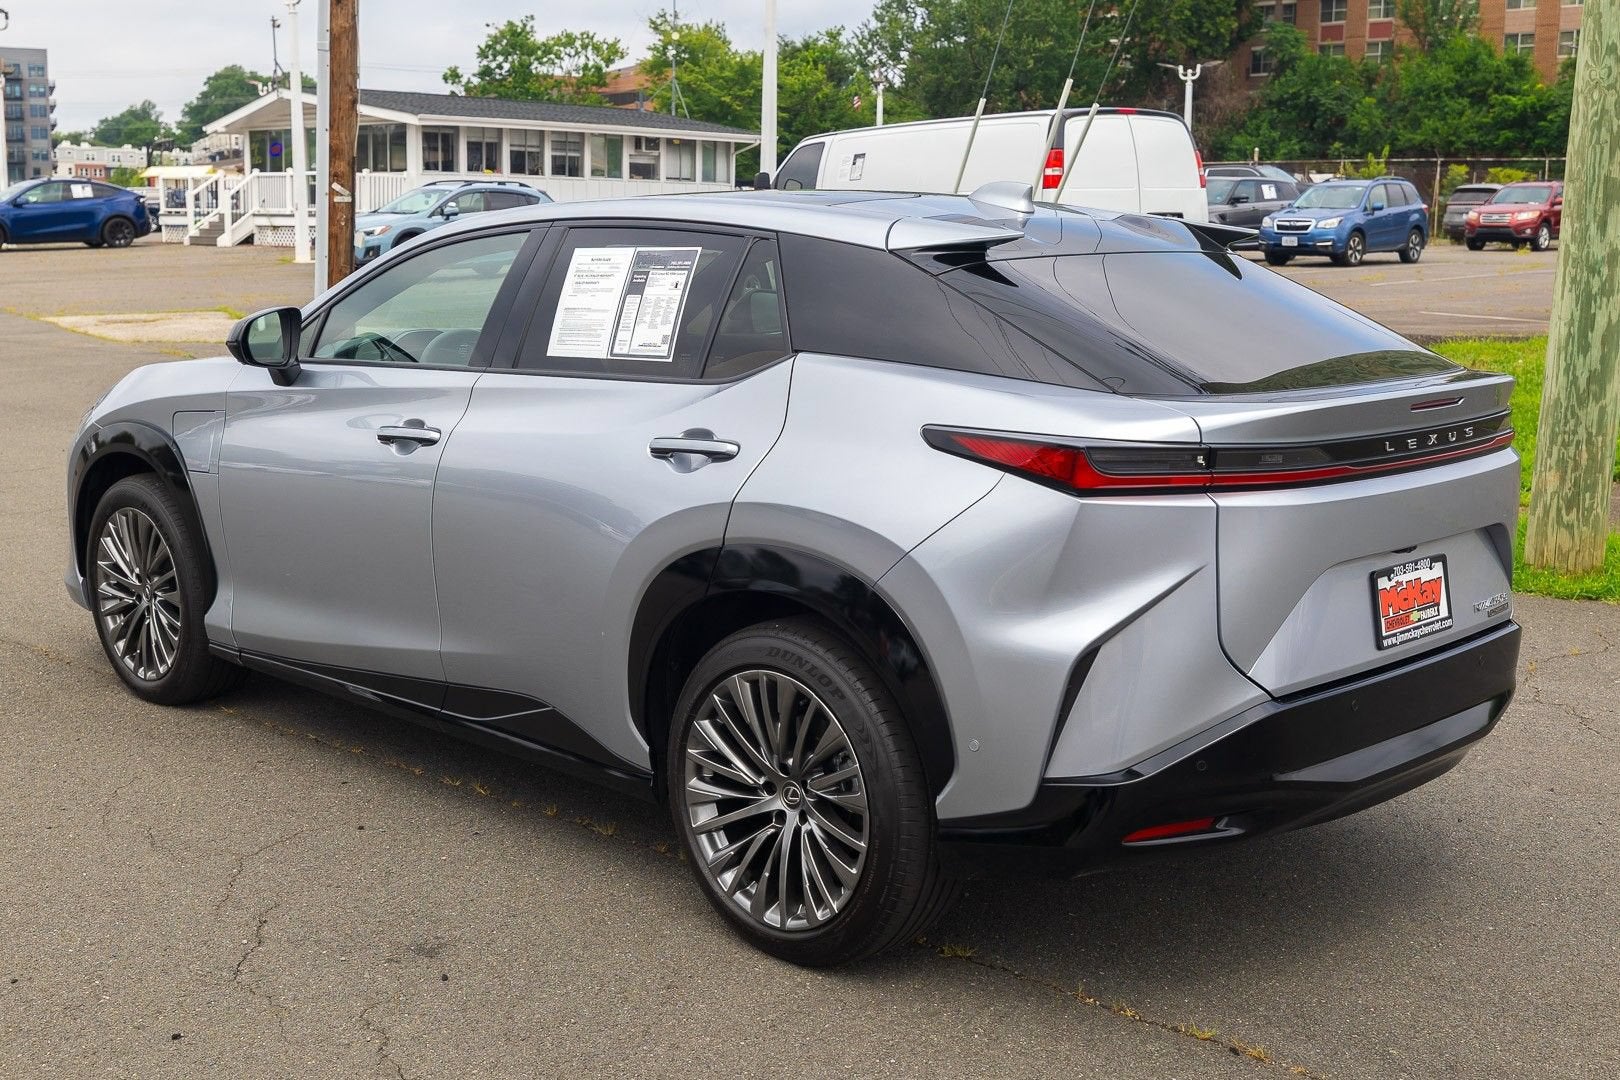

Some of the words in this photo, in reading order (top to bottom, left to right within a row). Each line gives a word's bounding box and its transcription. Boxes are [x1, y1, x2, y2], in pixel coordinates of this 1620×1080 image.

[1385, 427, 1473, 452] LEXUS
[1379, 576, 1443, 618] McKay
[764, 646, 847, 701] DUNLOP
